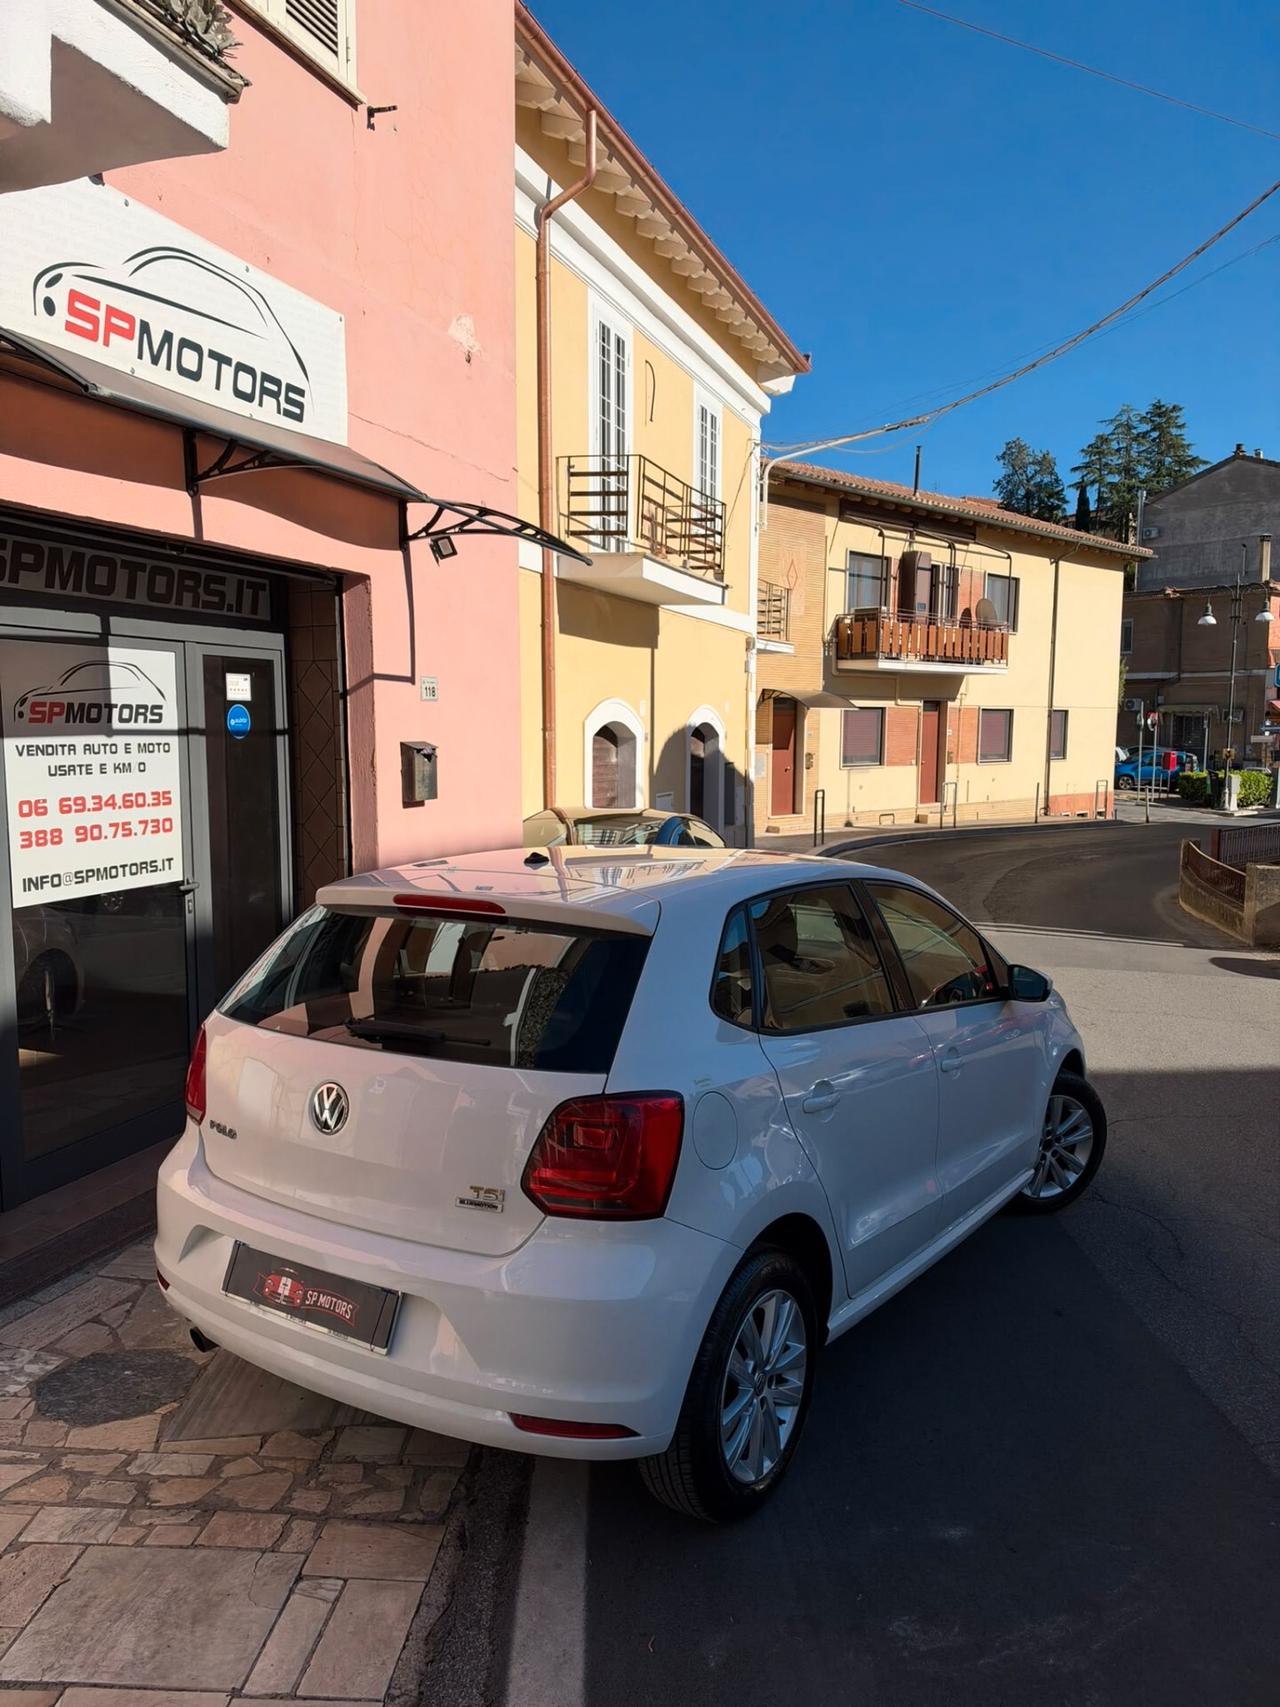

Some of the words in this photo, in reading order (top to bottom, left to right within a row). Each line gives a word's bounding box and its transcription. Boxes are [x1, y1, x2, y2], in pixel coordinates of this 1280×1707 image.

[65, 288, 305, 423] SPMOTORS
[0, 539, 267, 616] PMOTORS.IT
[425, 686, 436, 697] 118
[28, 701, 163, 724] SPMOTORS
[16, 744, 76, 757] VENDITA
[83, 743, 118, 756] AUTO
[124, 743, 132, 754] E
[137, 742, 171, 754] MOTO
[48, 764, 93, 777] USATE
[100, 763, 107, 774] E
[113, 762, 132, 774] KM
[18, 799, 48, 818] 06
[59, 790, 172, 815] 69.34.60.35
[19, 828, 63, 849] 388
[75, 817, 173, 843] 90.75.730
[22, 857, 174, 892] INFO@SPMOTORS.IT
[305, 1290, 317, 1305] SP
[319, 1292, 353, 1319] MOTORS
